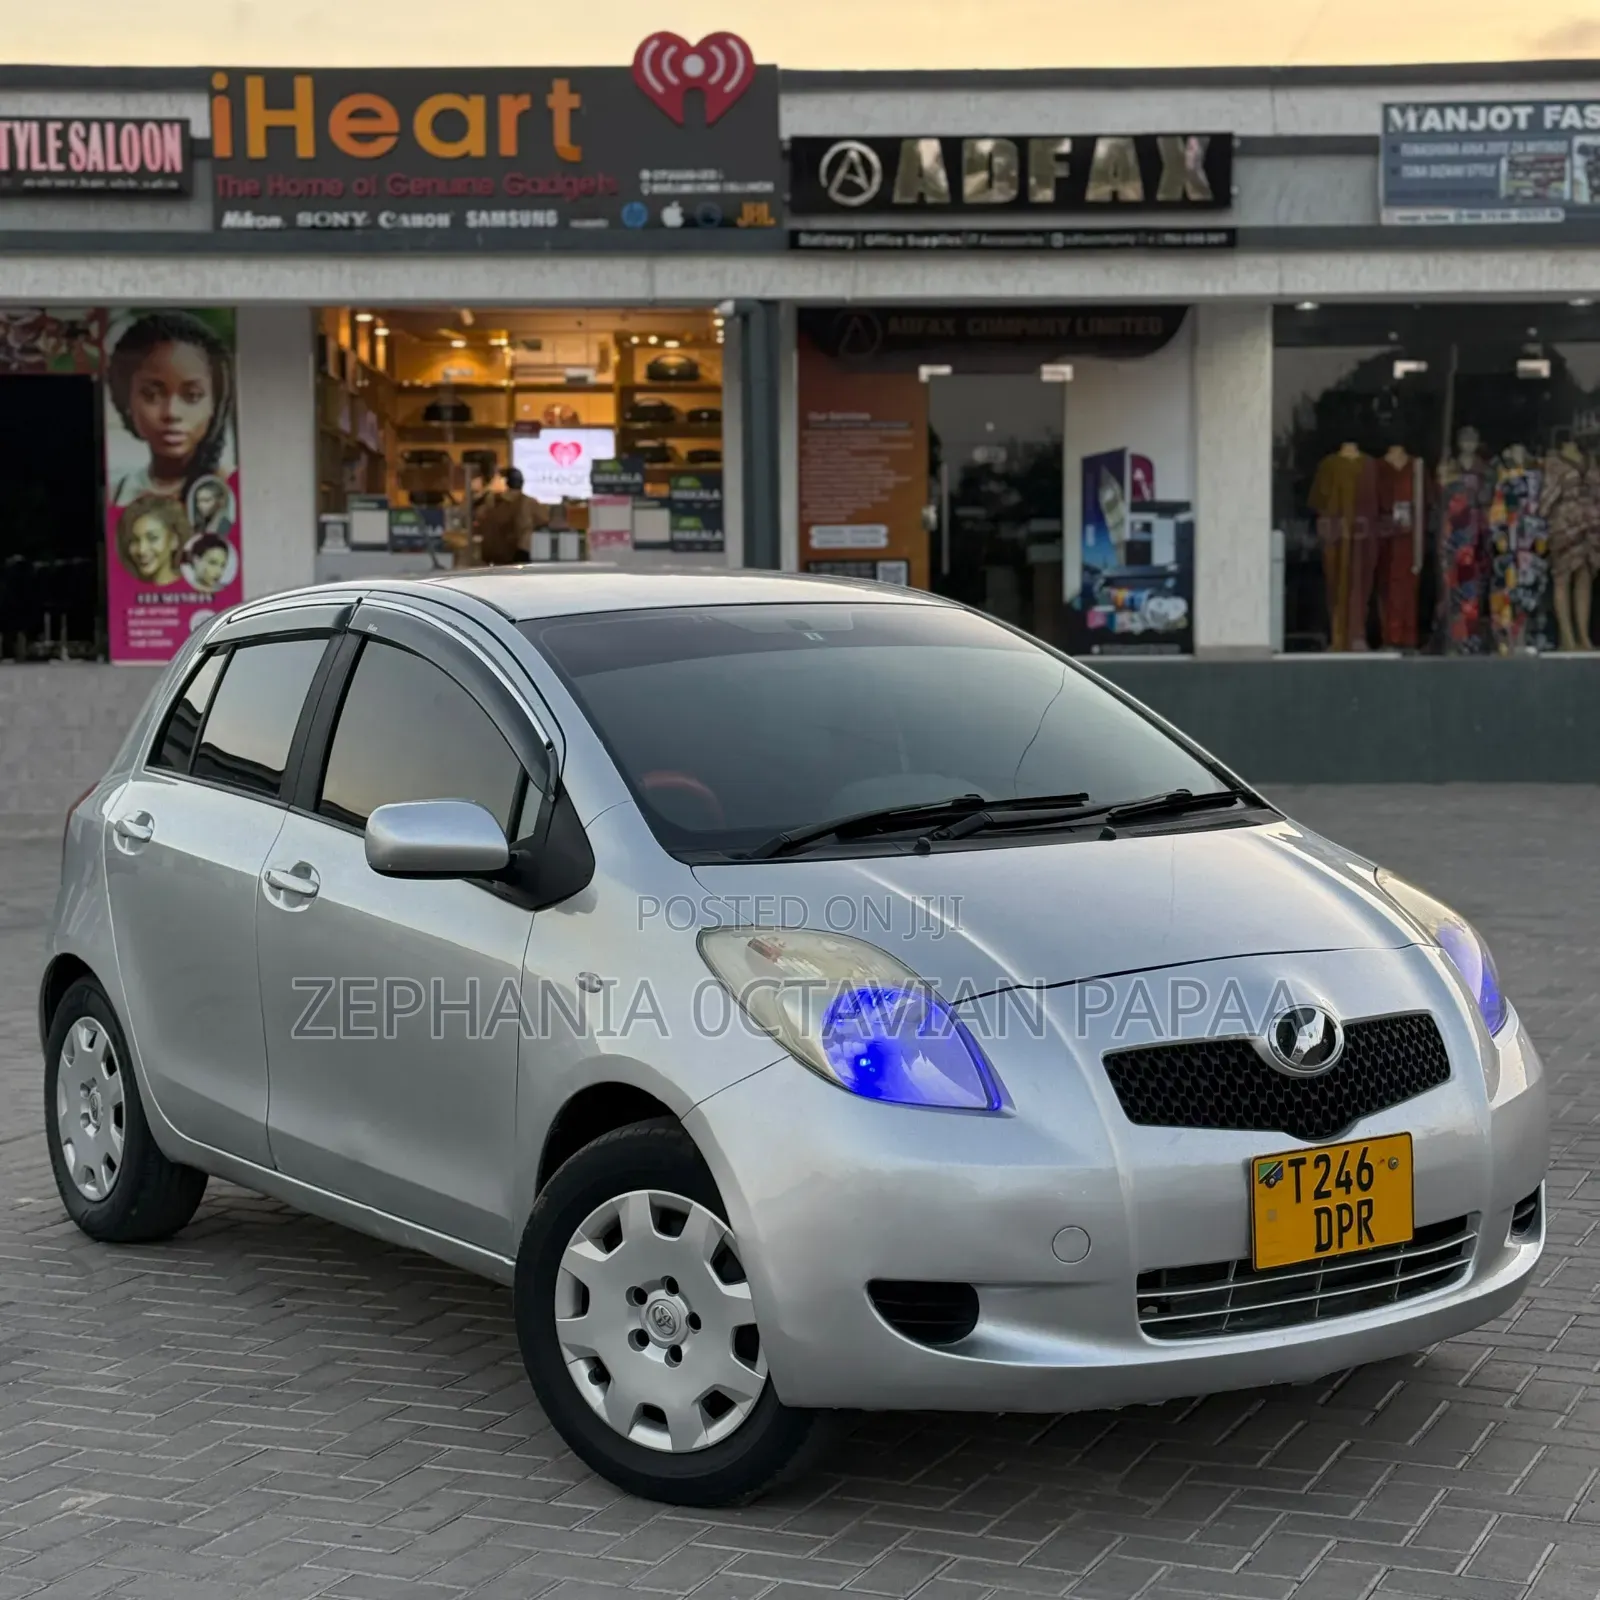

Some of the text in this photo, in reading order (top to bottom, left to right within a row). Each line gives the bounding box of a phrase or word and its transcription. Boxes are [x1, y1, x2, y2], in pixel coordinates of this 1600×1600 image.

[211, 71, 582, 162] iHeart
[1388, 104, 1534, 132] MANJOT
[0, 120, 182, 173] TYLE SALOON
[892, 136, 1213, 204] ADFAX
[216, 174, 261, 197] The
[267, 172, 343, 197] Home
[353, 173, 377, 196] of
[387, 172, 494, 197] Genuine
[503, 171, 618, 202] Gadgets
[221, 210, 285, 229] Nikon
[296, 210, 368, 228] SONY
[466, 209, 558, 228] SAMSUNG
[1314, 1198, 1375, 1253] DPR
